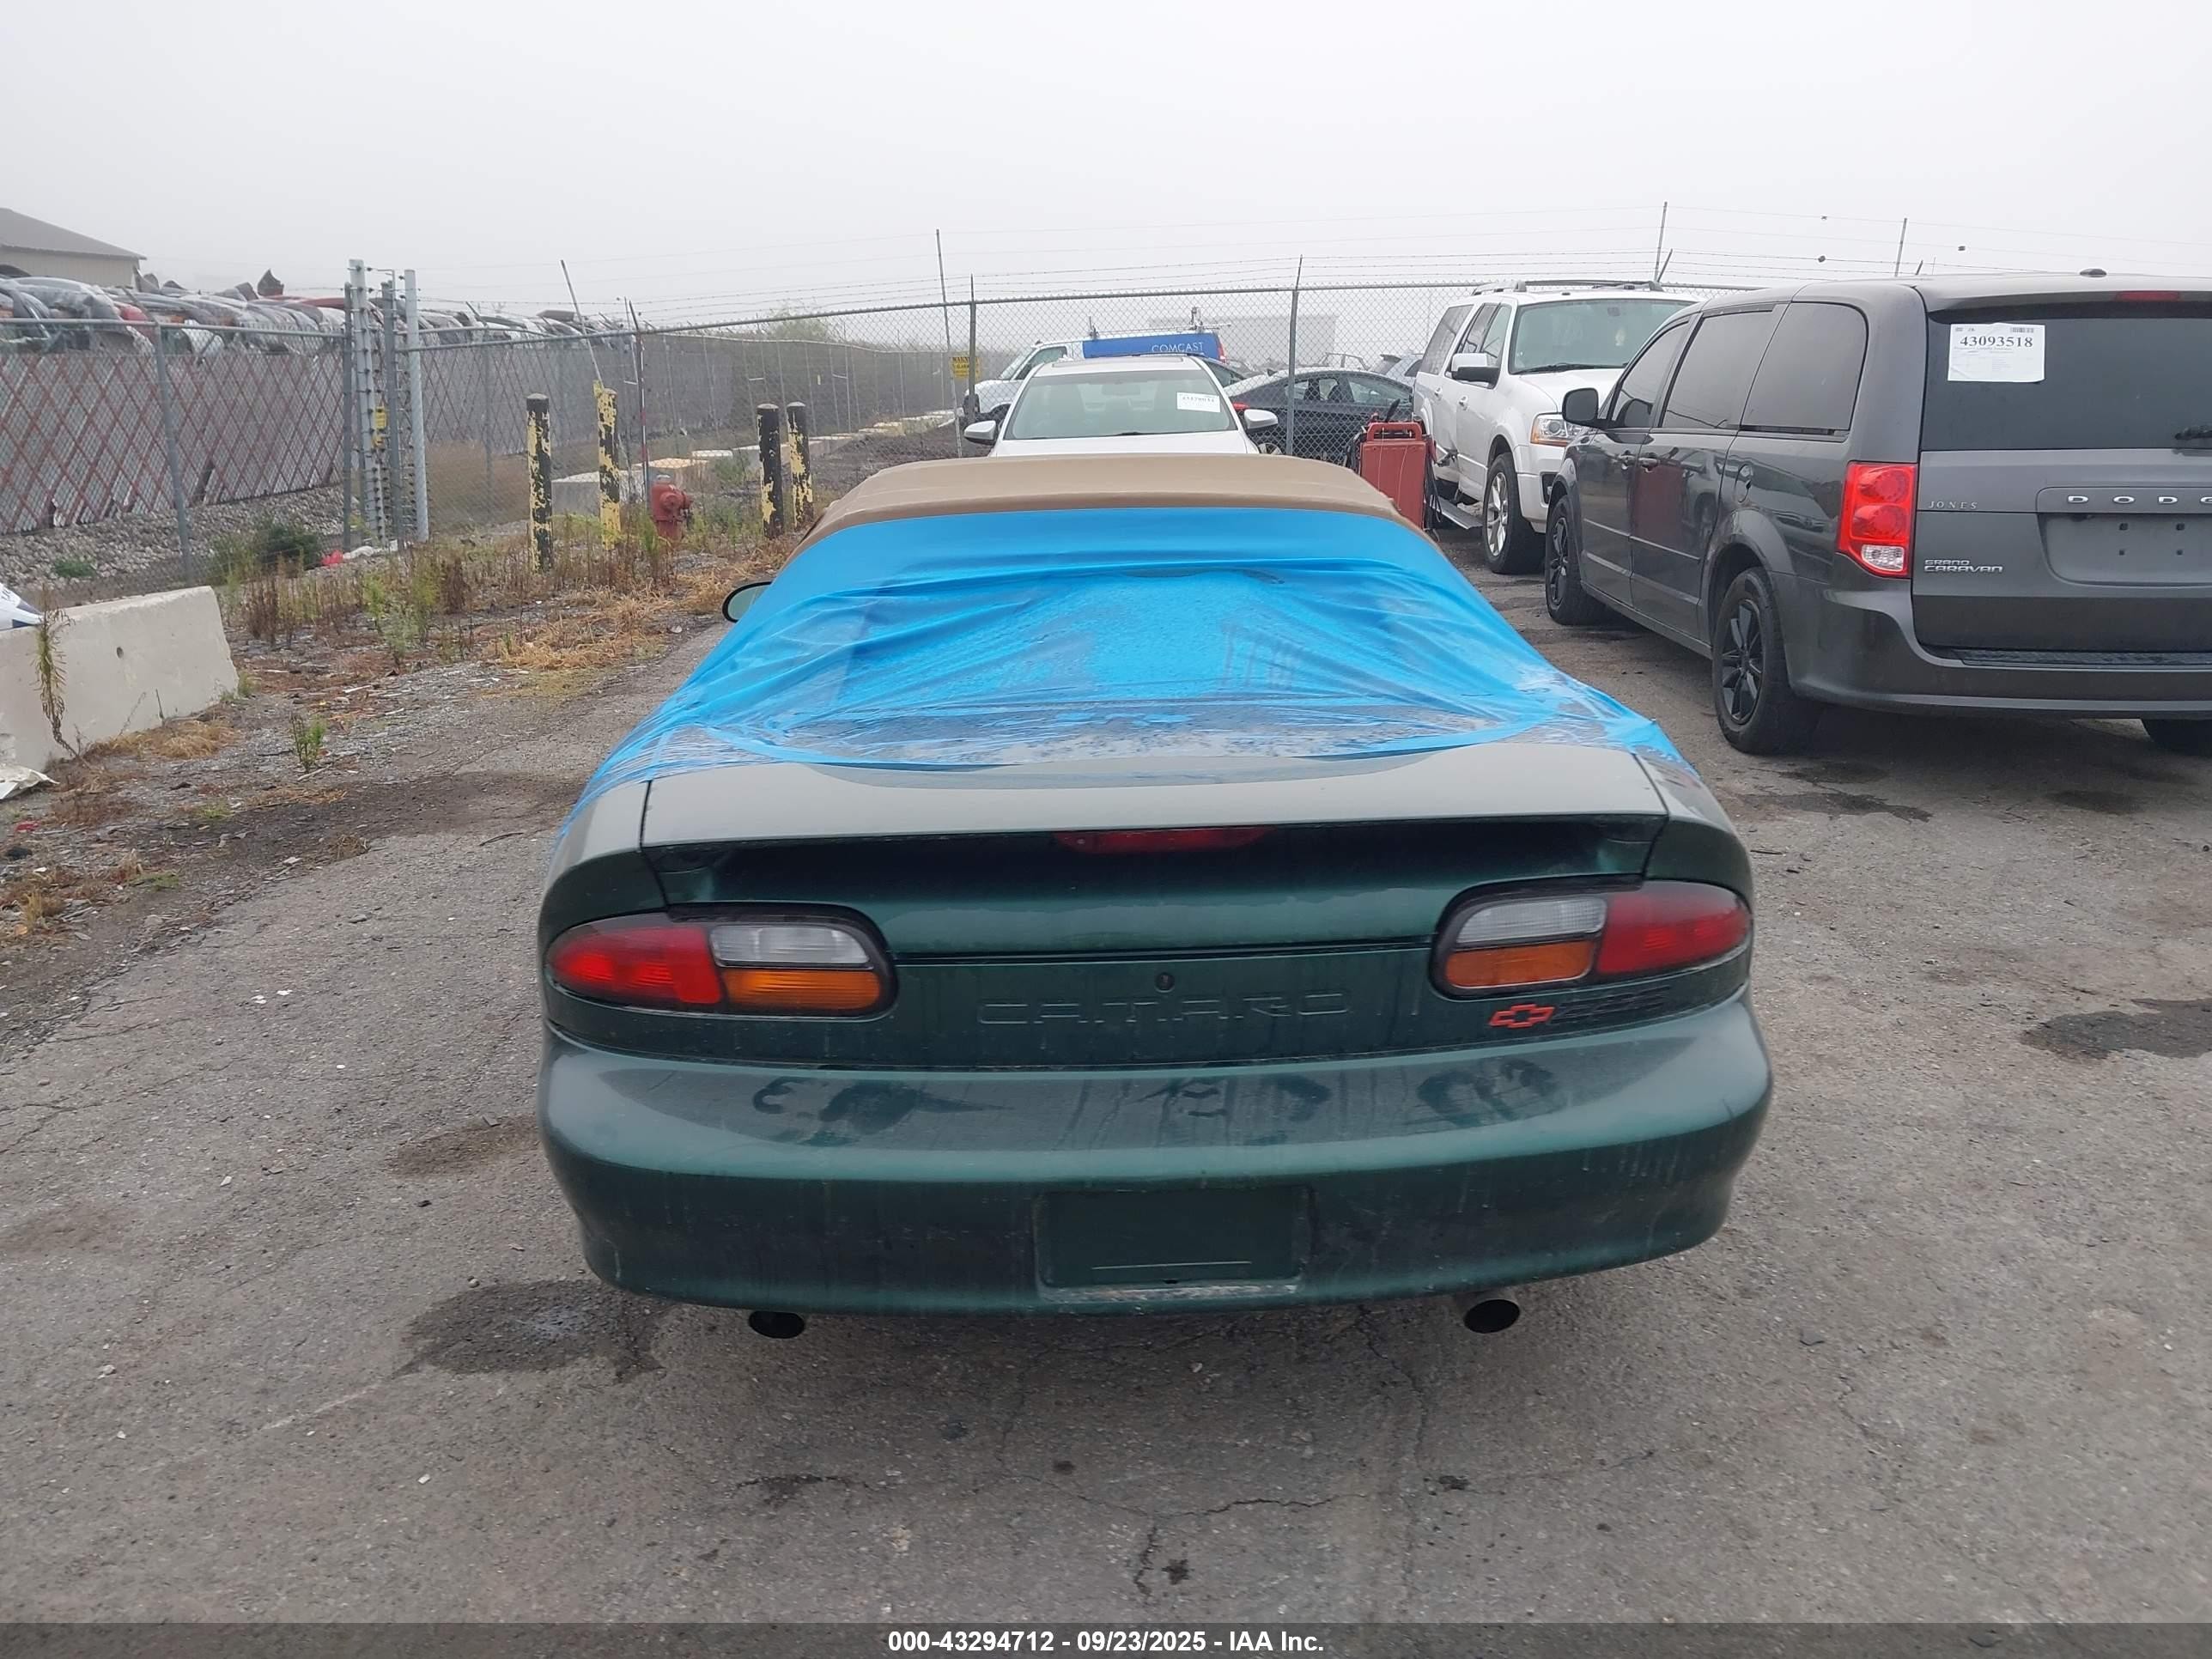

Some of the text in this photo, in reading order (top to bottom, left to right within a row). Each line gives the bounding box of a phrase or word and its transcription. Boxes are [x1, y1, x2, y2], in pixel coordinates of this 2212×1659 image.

[1151, 342, 1204, 353] COMCAST
[1960, 336, 2033, 348] 43093518
[1929, 501, 1978, 509] JONES
